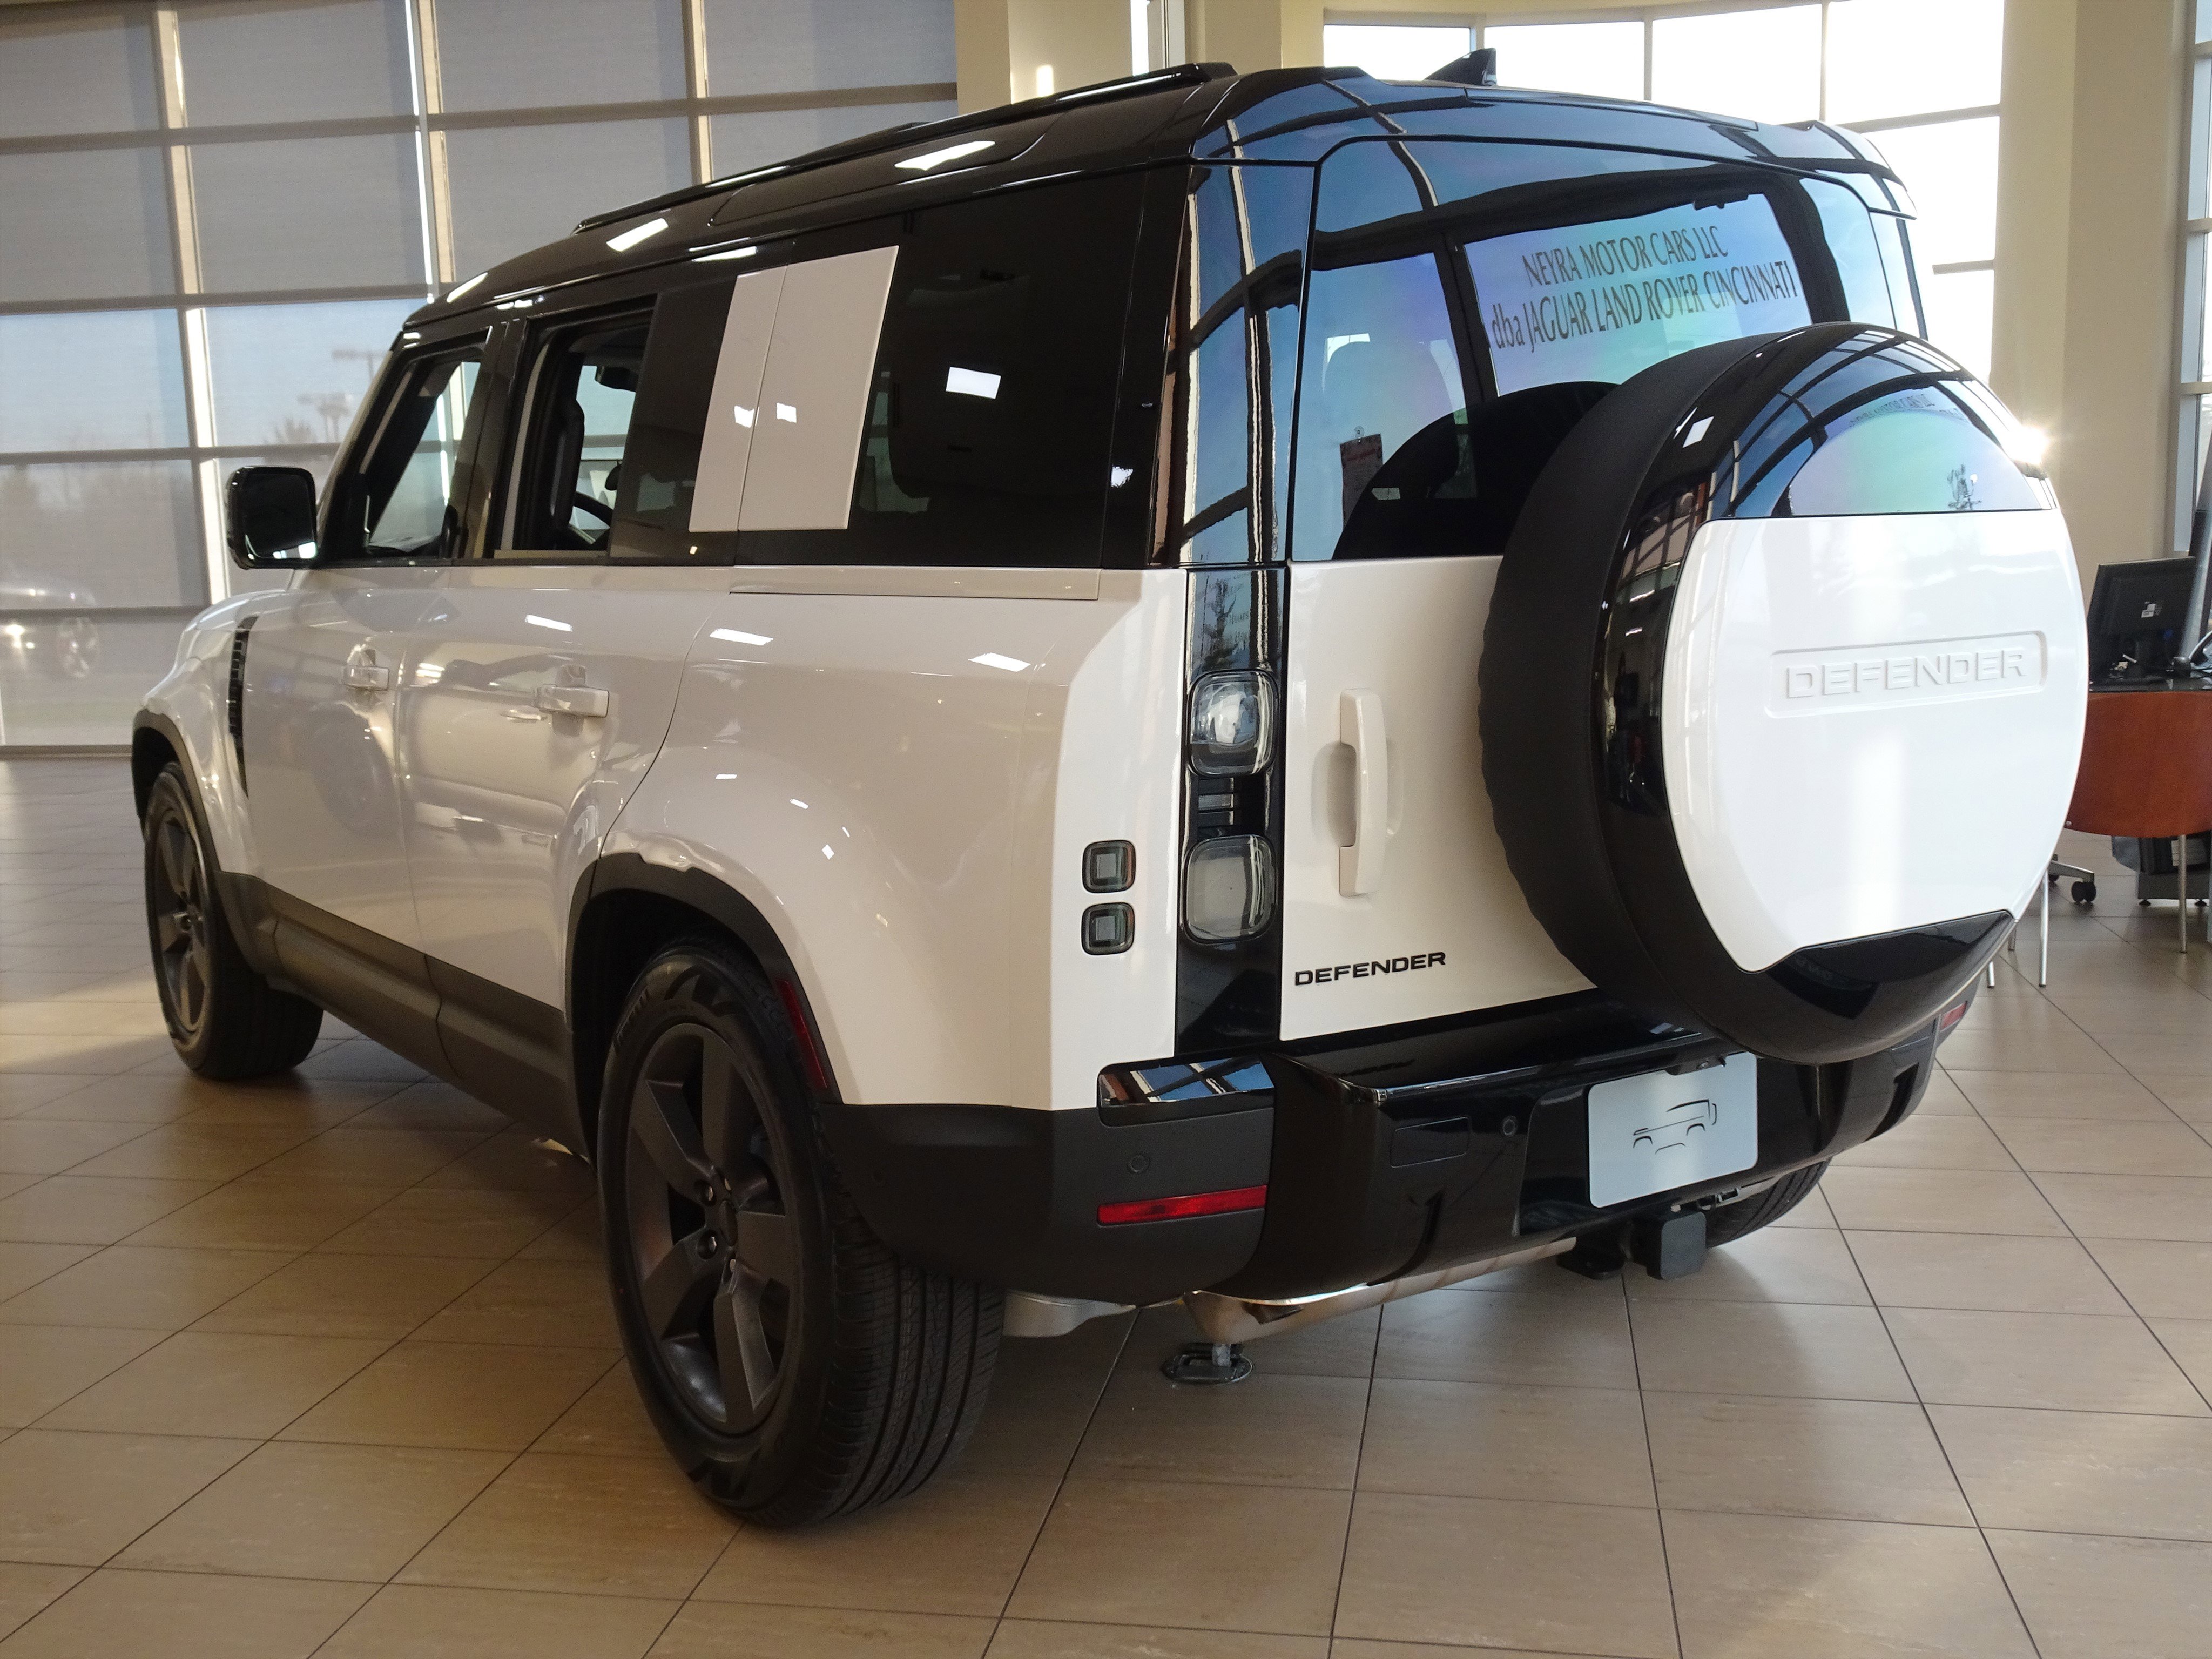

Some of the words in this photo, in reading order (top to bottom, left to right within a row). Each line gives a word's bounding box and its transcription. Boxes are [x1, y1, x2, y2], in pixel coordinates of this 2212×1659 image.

[1522, 246, 1583, 287] NEYRA
[1579, 235, 1653, 278] MOTOR
[1650, 227, 1697, 265] CARS
[1692, 225, 1728, 259] LLC
[1491, 302, 1526, 349] dba
[1522, 291, 1594, 353] JAGUAR
[1591, 283, 1643, 332] LAND
[1642, 273, 1705, 321] ROVER
[1703, 260, 1798, 309] CINCINNATI
[1785, 648, 2026, 699] DEFENDER
[1294, 951, 1446, 986] DEFENDER
